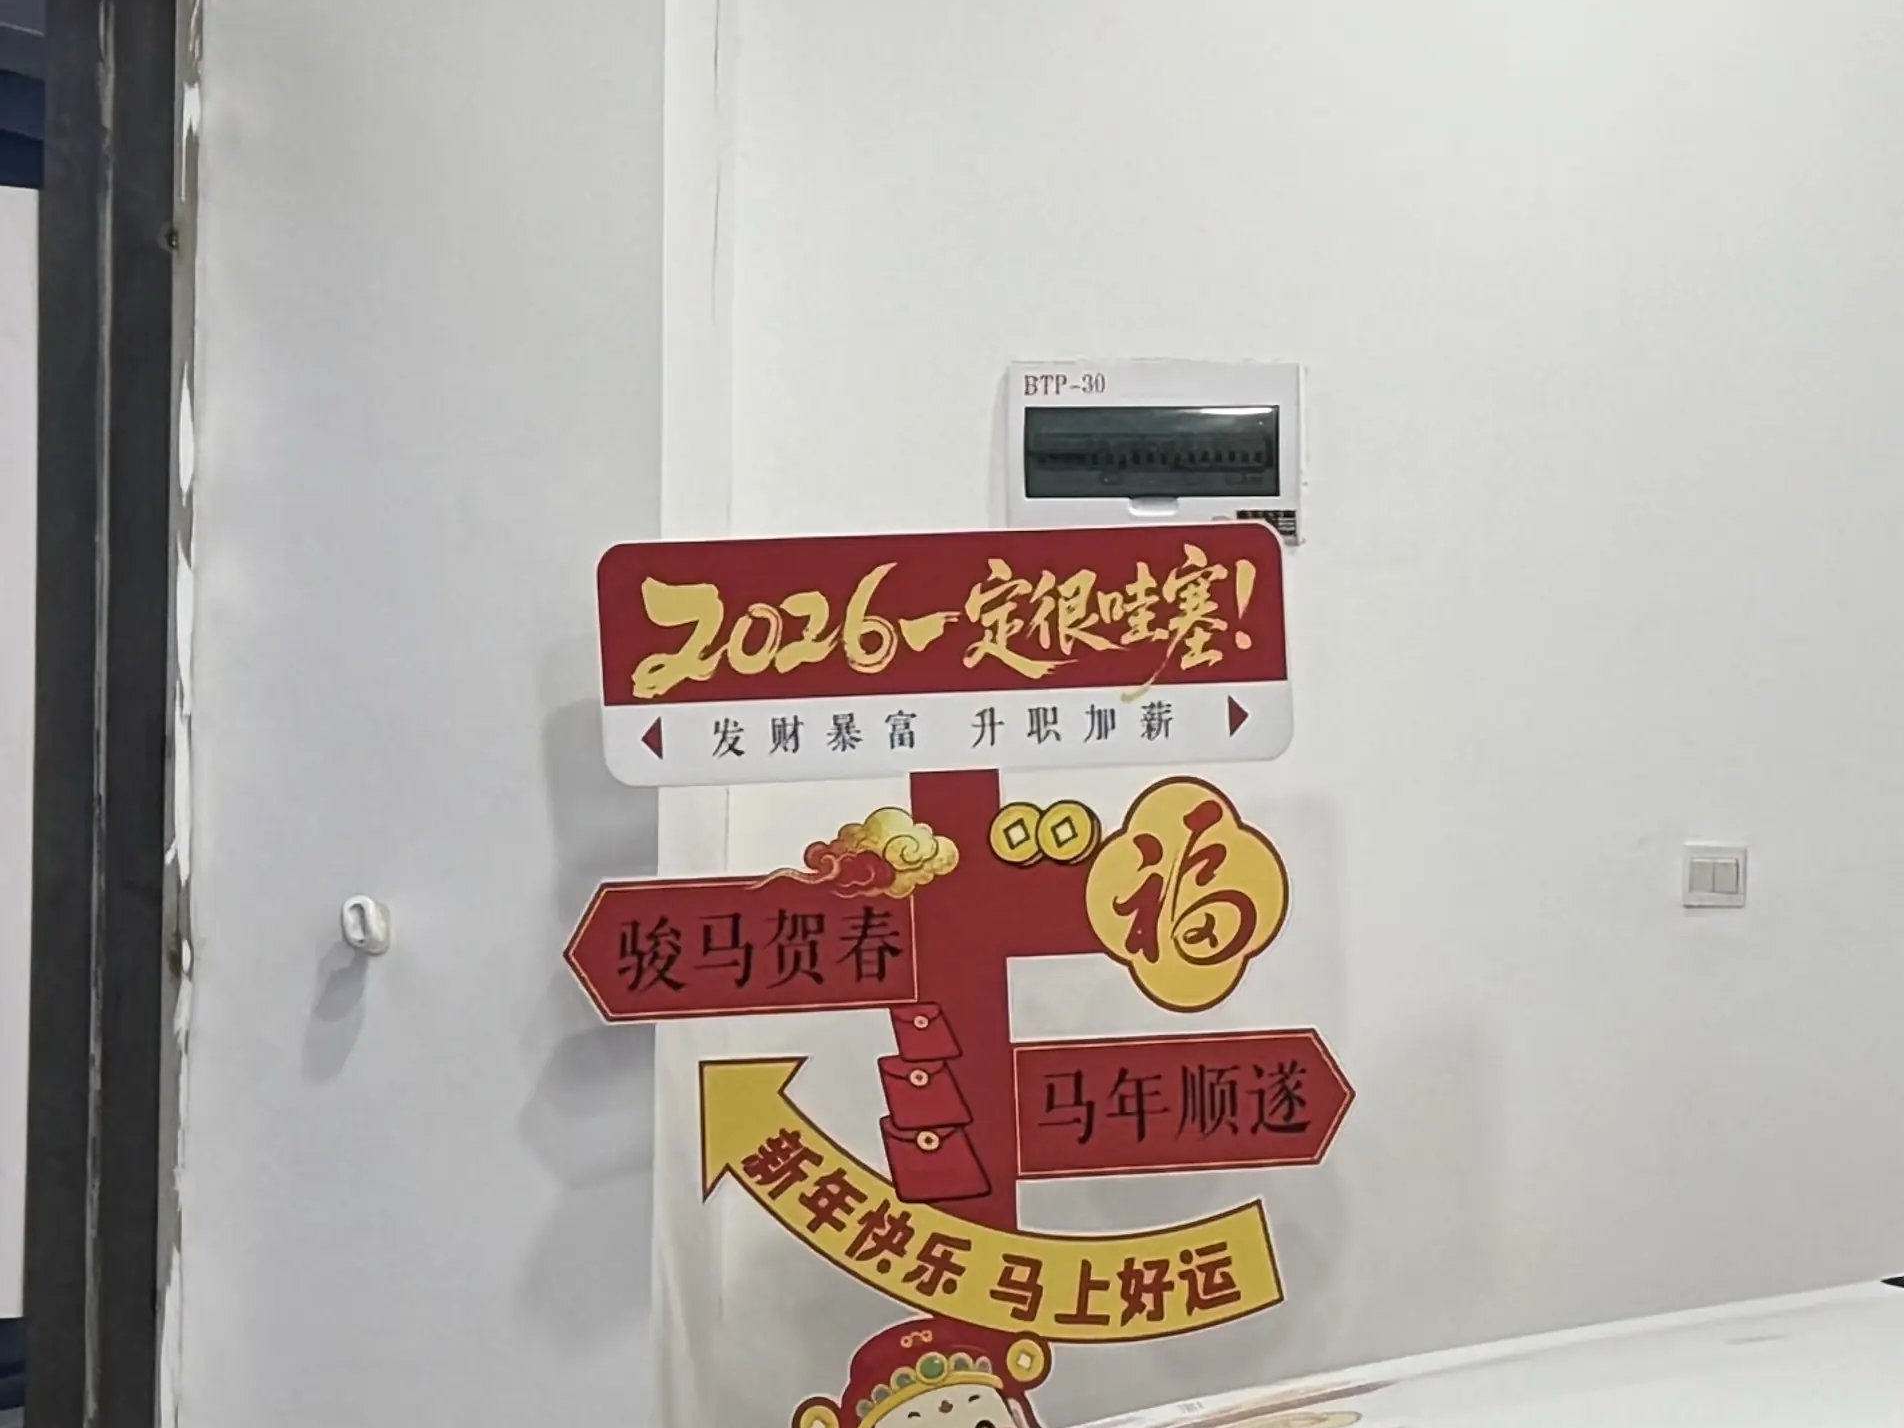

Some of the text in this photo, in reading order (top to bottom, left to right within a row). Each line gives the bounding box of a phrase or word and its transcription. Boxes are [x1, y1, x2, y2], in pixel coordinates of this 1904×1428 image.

[1023, 373, 1107, 396] BTP-30
[712, 698, 1176, 758] 发财暴富 升职加薪
[1111, 798, 1258, 965] 福
[617, 903, 905, 994] 骏马贺春
[1036, 1060, 1311, 1142] 马年顺遂
[740, 1126, 1242, 1328] 新年快乐 马上好运
